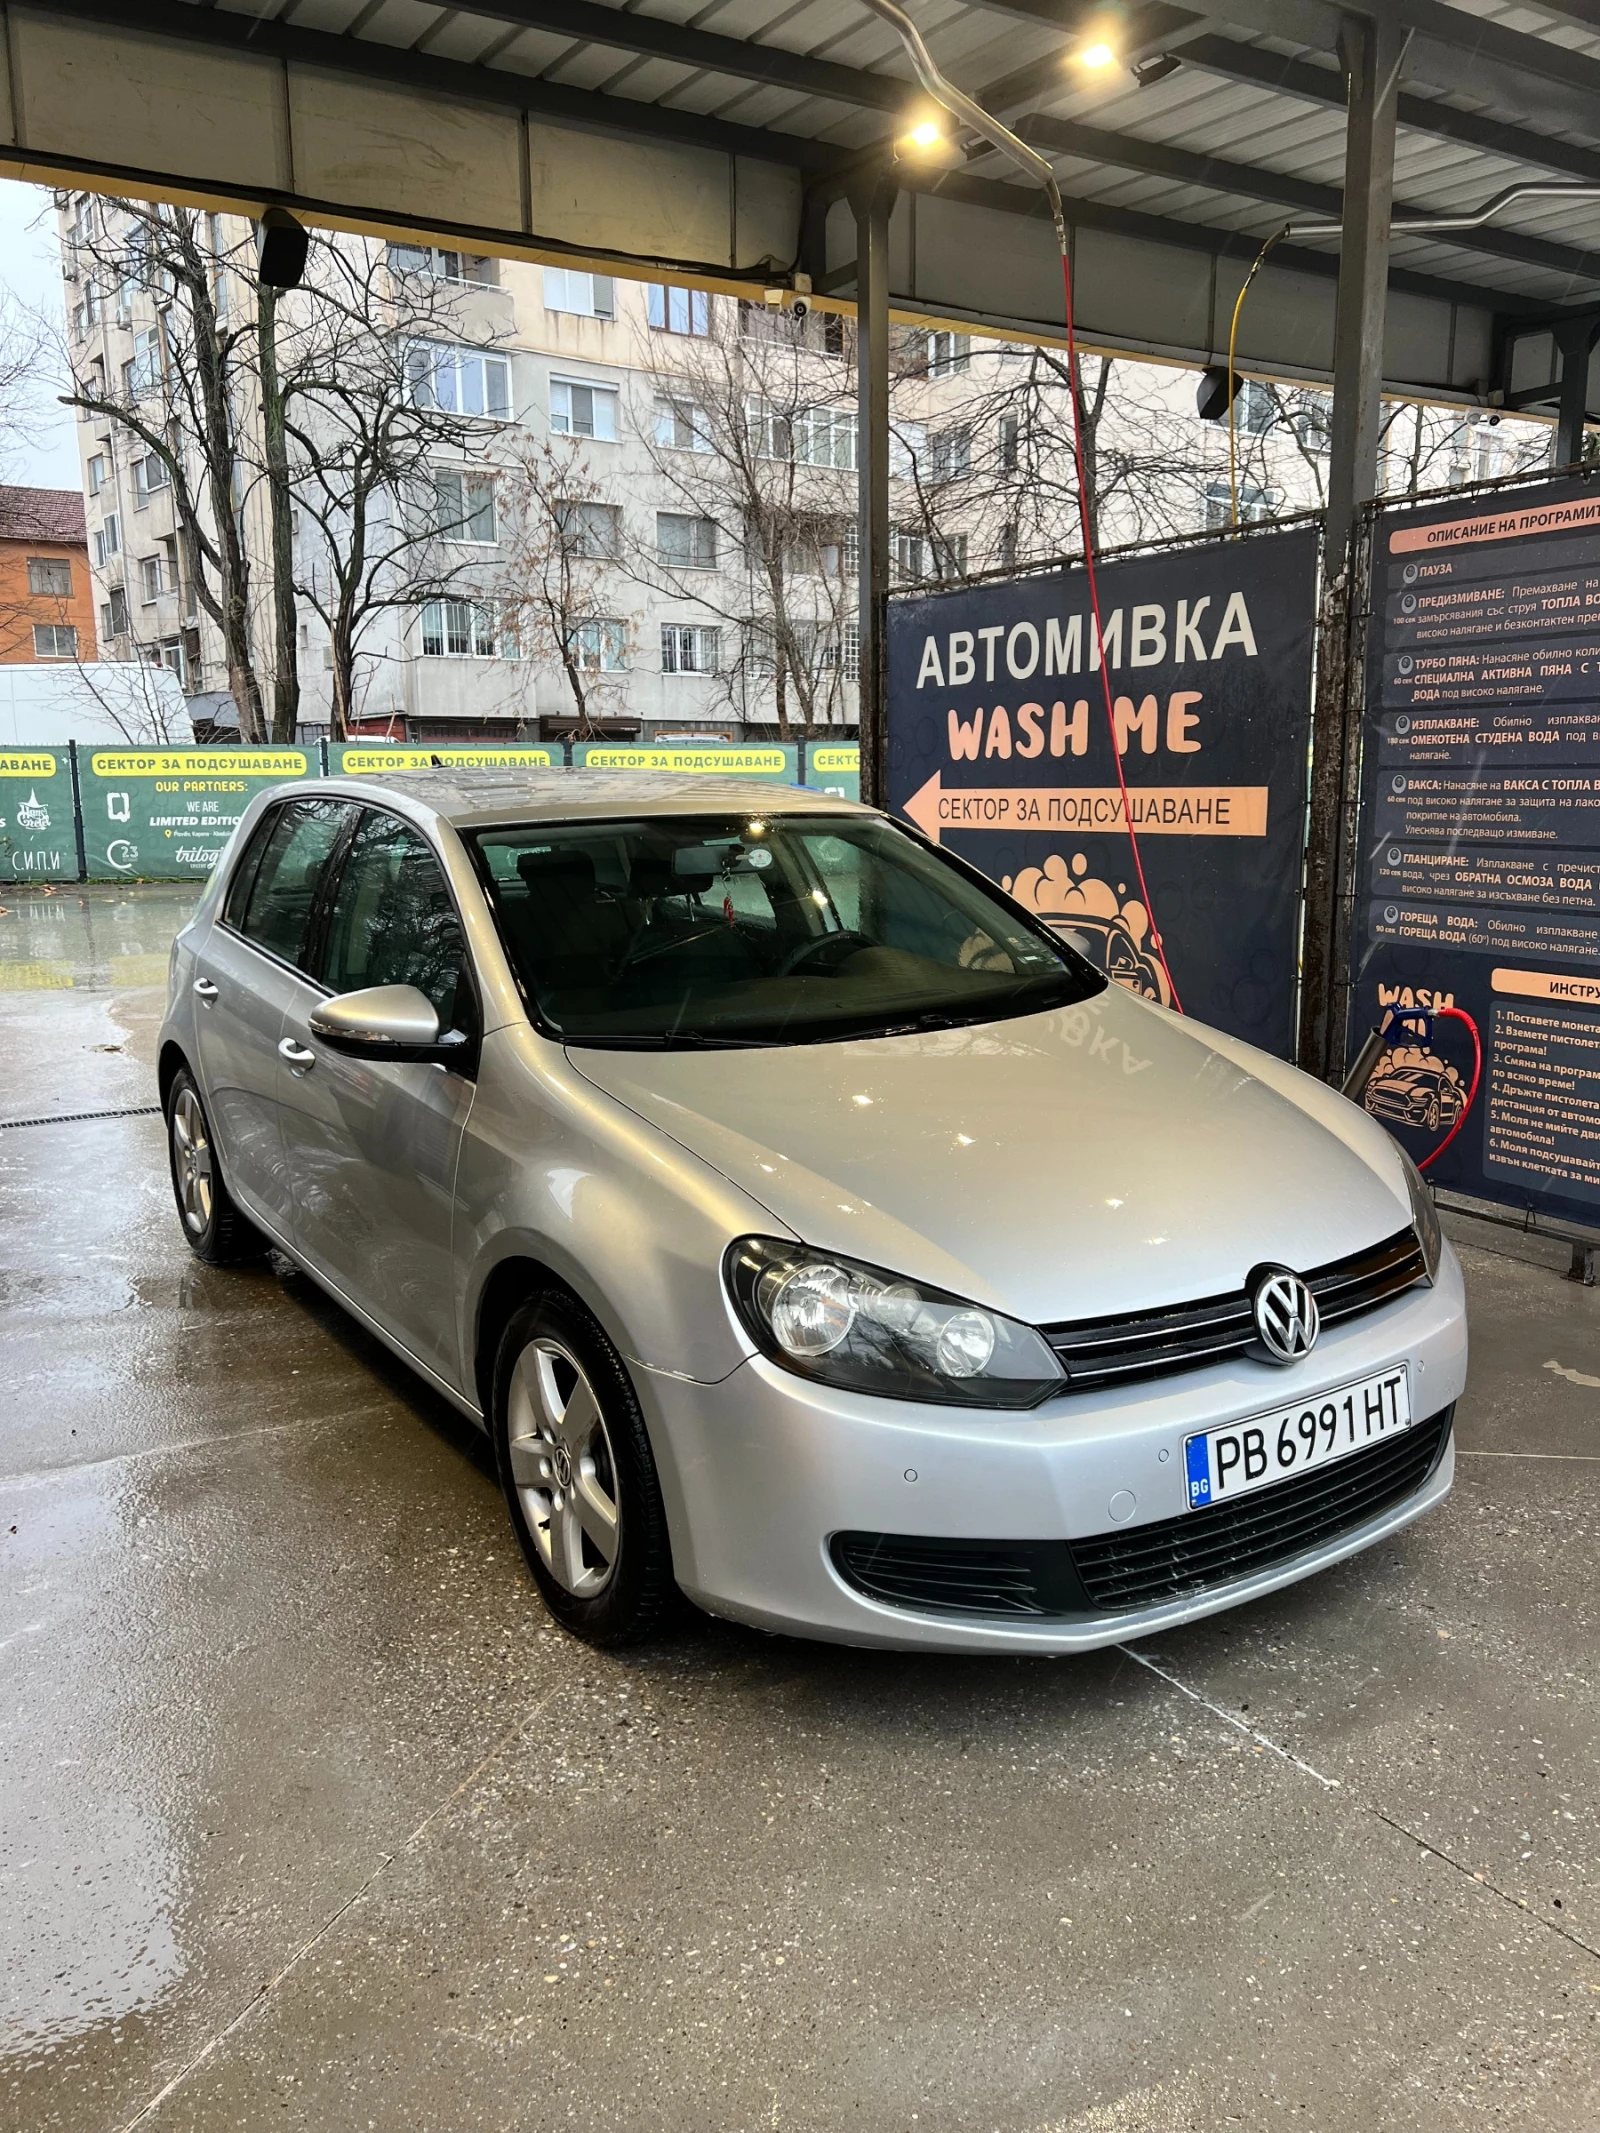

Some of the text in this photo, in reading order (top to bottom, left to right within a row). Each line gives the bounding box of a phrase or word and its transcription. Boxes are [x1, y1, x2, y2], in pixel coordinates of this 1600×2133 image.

[1427, 522, 1495, 543] ОПИСАНИЕ
[1499, 519, 1516, 533] НА
[1419, 563, 1453, 577] ПАУЗА
[1418, 579, 1599, 609] ПРЕДИЗМИВАНЕ: Премахване на
[1417, 608, 1483, 624] замърсявания
[1486, 606, 1504, 615] със
[1508, 603, 1537, 616] струя
[1541, 595, 1581, 610] ТОПЛА
[1416, 615, 1574, 639] високо налягане и безконтактен
[915, 591, 1259, 689] АВТОМИВКА
[1415, 647, 1573, 670] ТУРБО ПЯНА: Нанасяне обилно
[1414, 671, 1475, 686] СПЕЦИАЛНА
[1481, 666, 1532, 680] АКТИВНА
[1540, 663, 1572, 677] ПЯНА
[1580, 662, 1589, 673] С
[1413, 682, 1545, 702] ВОДА под високо налягане.
[947, 690, 1204, 761] WASH ME
[1412, 716, 1532, 730] ИЗПЛАКВАНЕ: Обилно
[1411, 731, 1586, 745] ОМЕКОТЕНА СТУДЕНА ВОДА под
[97, 758, 303, 771] СЕКТОР ЗА ПОДСУШАВАНЕ
[347, 757, 429, 768] СЕКТОР ЗА
[590, 755, 782, 768] СЕКТОР ЗА ПОДСУШАВАНЕ
[1409, 750, 1452, 760] налягане.
[155, 780, 249, 792] OUR PARTNERS:
[1407, 779, 1591, 791] ВАКСА: Нанасяне на ВАКСА С ТОПЛА
[186, 801, 219, 813] WE ARE
[1407, 797, 1424, 807] под
[1426, 797, 1457, 806] високо
[1460, 796, 1503, 807] налягане
[1505, 798, 1516, 807] за
[1519, 796, 1556, 808] защита
[1559, 798, 1572, 807] на
[150, 816, 199, 827] LIMITED
[938, 797, 1231, 827] СЕКТОР ЗА ПОДСУШАВАНЕ
[1406, 811, 1522, 823] покритие на автомобила.
[1405, 824, 1558, 840] Улеснява последващо измиване.
[12, 850, 61, 871] С.И.П.И
[1403, 853, 1549, 871] ГЛАНЦИРАНЕ: Изплакване с
[1379, 868, 1390, 876] 120
[1402, 870, 1425, 881] вода,
[1429, 871, 1450, 883] чрез
[1455, 872, 1501, 885] ОБРАТНА
[1507, 875, 1554, 888] ОСМОЗА
[1559, 878, 1592, 891] ВОДА
[1401, 884, 1596, 906] високо налягане за изсъхване без петна.
[1376, 925, 1385, 933] 90
[1400, 911, 1598, 940] ГОРЕЩА ВОДА: Обилно изплакване
[1399, 926, 1437, 941] ГОРЕЩА
[1439, 930, 1466, 943] ВОДА
[1491, 937, 1510, 949] под
[1511, 940, 1547, 951] високо
[1550, 944, 1600, 957] налягане.
[1378, 983, 1455, 1010] WASH
[1496, 1010, 1505, 1020] 1.
[1506, 1011, 1560, 1028] Поставете
[1495, 1024, 1548, 1041] 2. Вземете
[1494, 1040, 1547, 1056] програма!
[1493, 1053, 1502, 1063] 3.
[1504, 1055, 1537, 1069] Смяна
[1539, 1062, 1552, 1072] на
[1492, 1069, 1575, 1091] по всяко време!
[1491, 1082, 1600, 1110] 4. Дръжте пистолета
[1490, 1097, 1545, 1115] дистанция
[1547, 1109, 1560, 1117] от
[1490, 1110, 1500, 1119] 5.
[1501, 1112, 1529, 1126] Моля
[1530, 1121, 1543, 1129] не
[1545, 1122, 1579, 1136] мийте
[1489, 1125, 1555, 1146] автомобила!
[1489, 1138, 1499, 1148] 6.
[1500, 1140, 1528, 1154] Моля
[1489, 1153, 1520, 1167] извън
[1521, 1161, 1568, 1178] клетката
[1570, 1171, 1582, 1181] за
[1216, 1375, 1402, 1490] PB 6991 HT
[1191, 1478, 1209, 1497] BG
